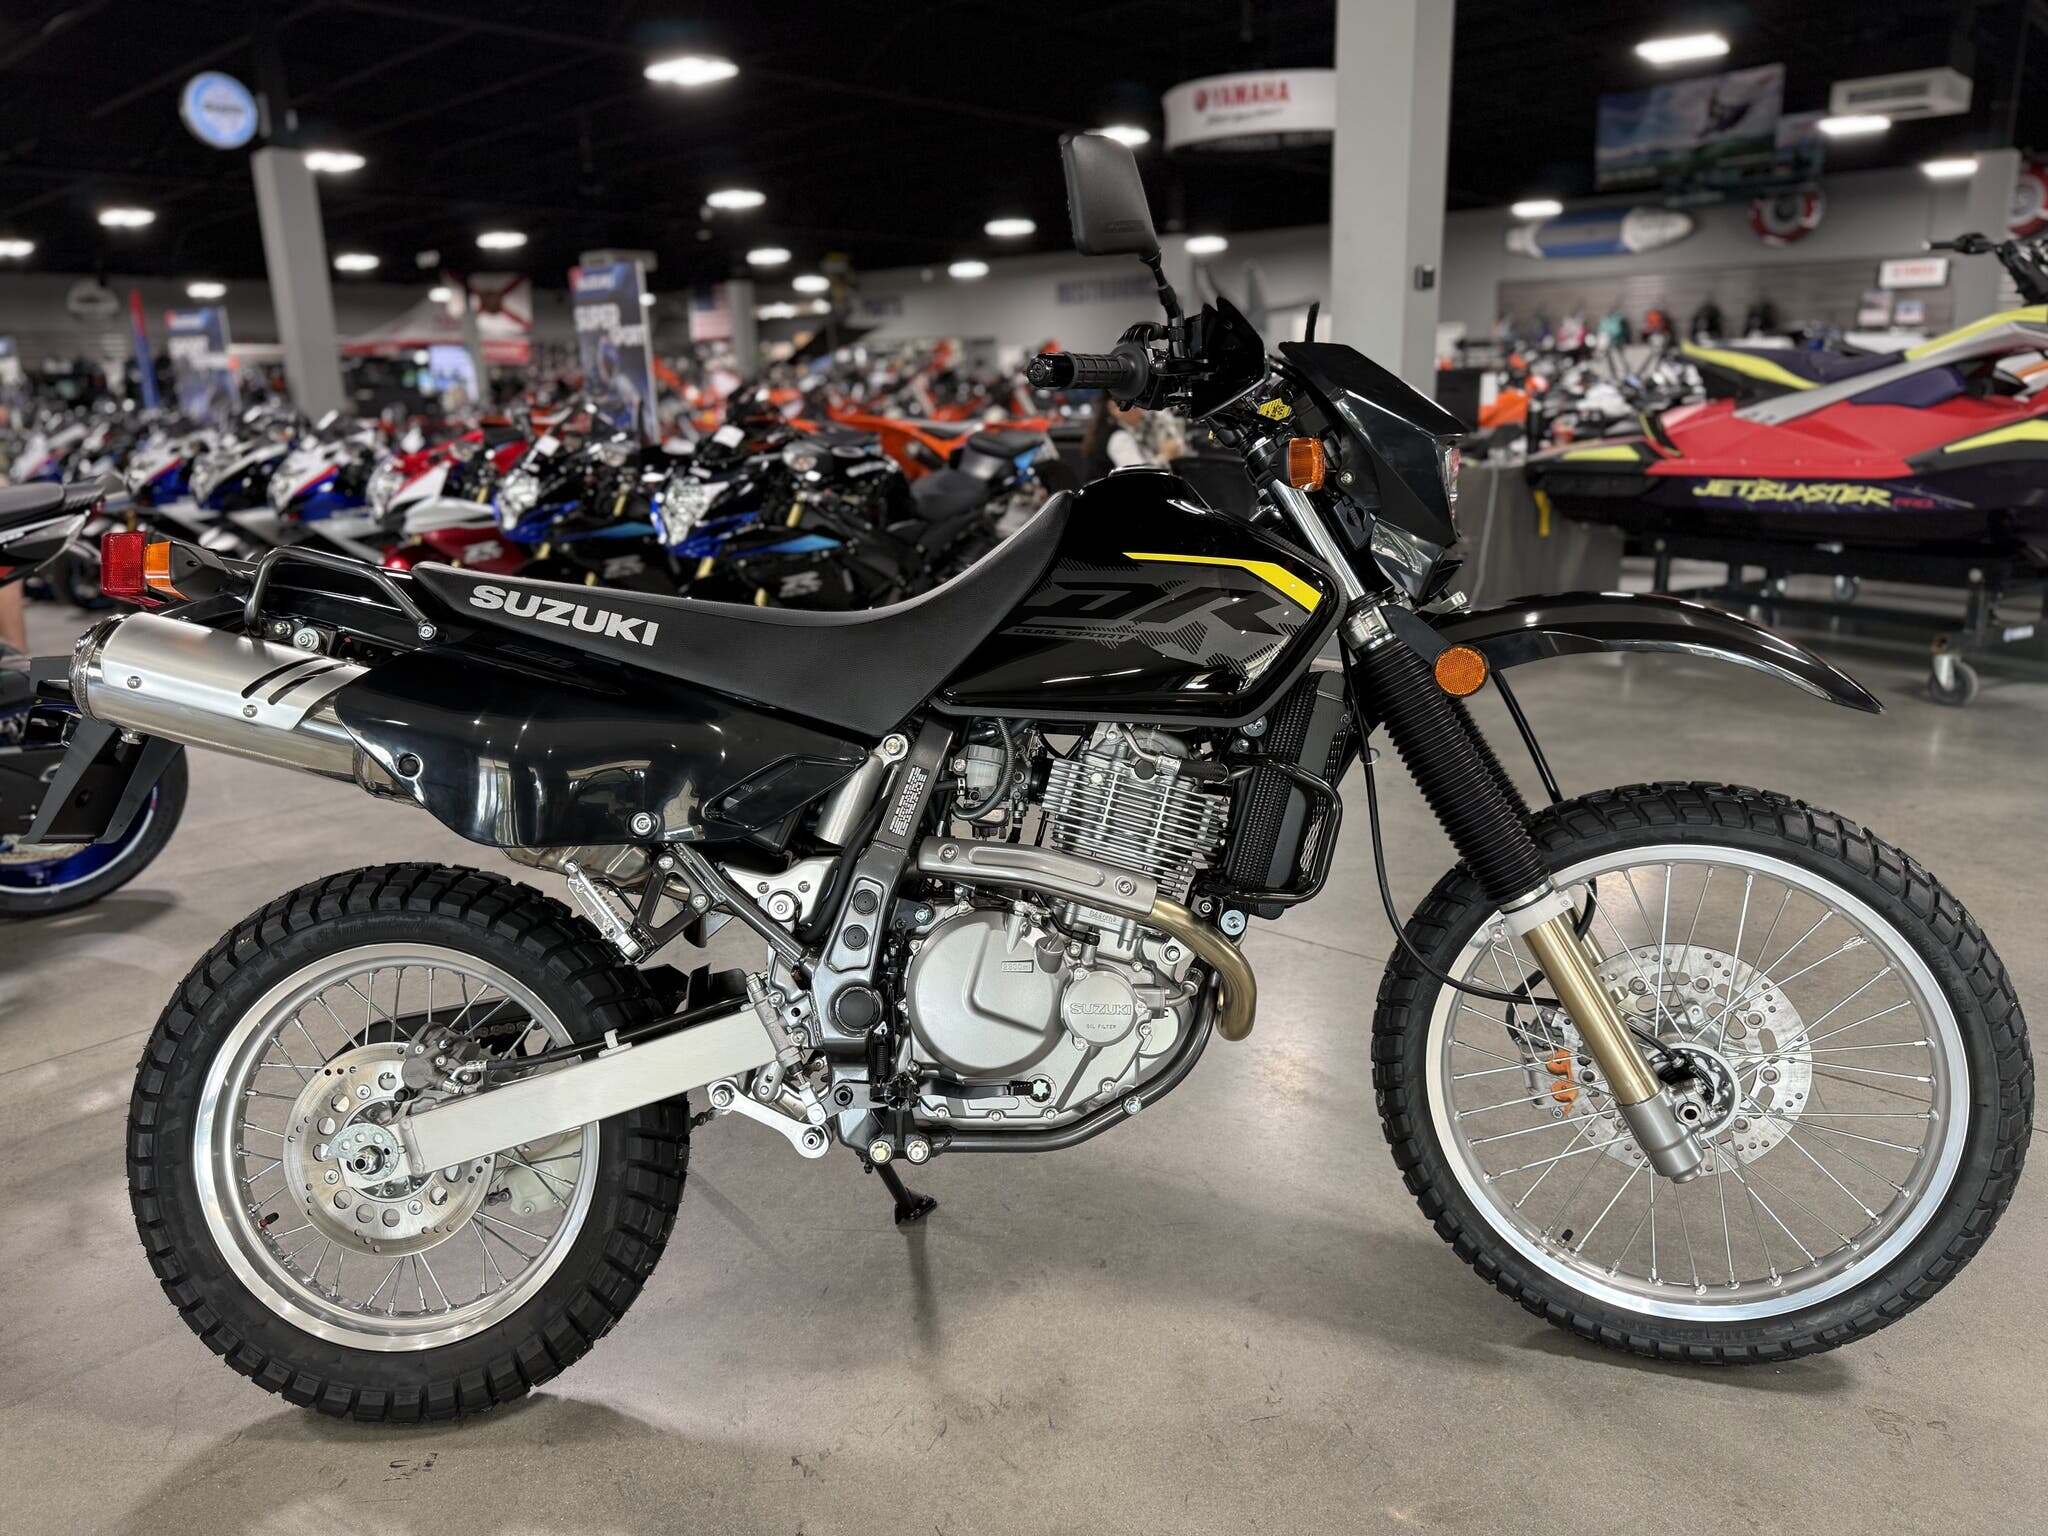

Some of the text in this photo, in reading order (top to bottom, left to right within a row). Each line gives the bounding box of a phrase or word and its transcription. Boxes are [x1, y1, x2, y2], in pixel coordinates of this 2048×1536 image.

[1693, 478, 1892, 507] JETBLASTER
[469, 585, 659, 646] SUZUKI
[1013, 627, 1129, 641] DUAL SPORT
[1070, 1003, 1132, 1016] SUZUKI
